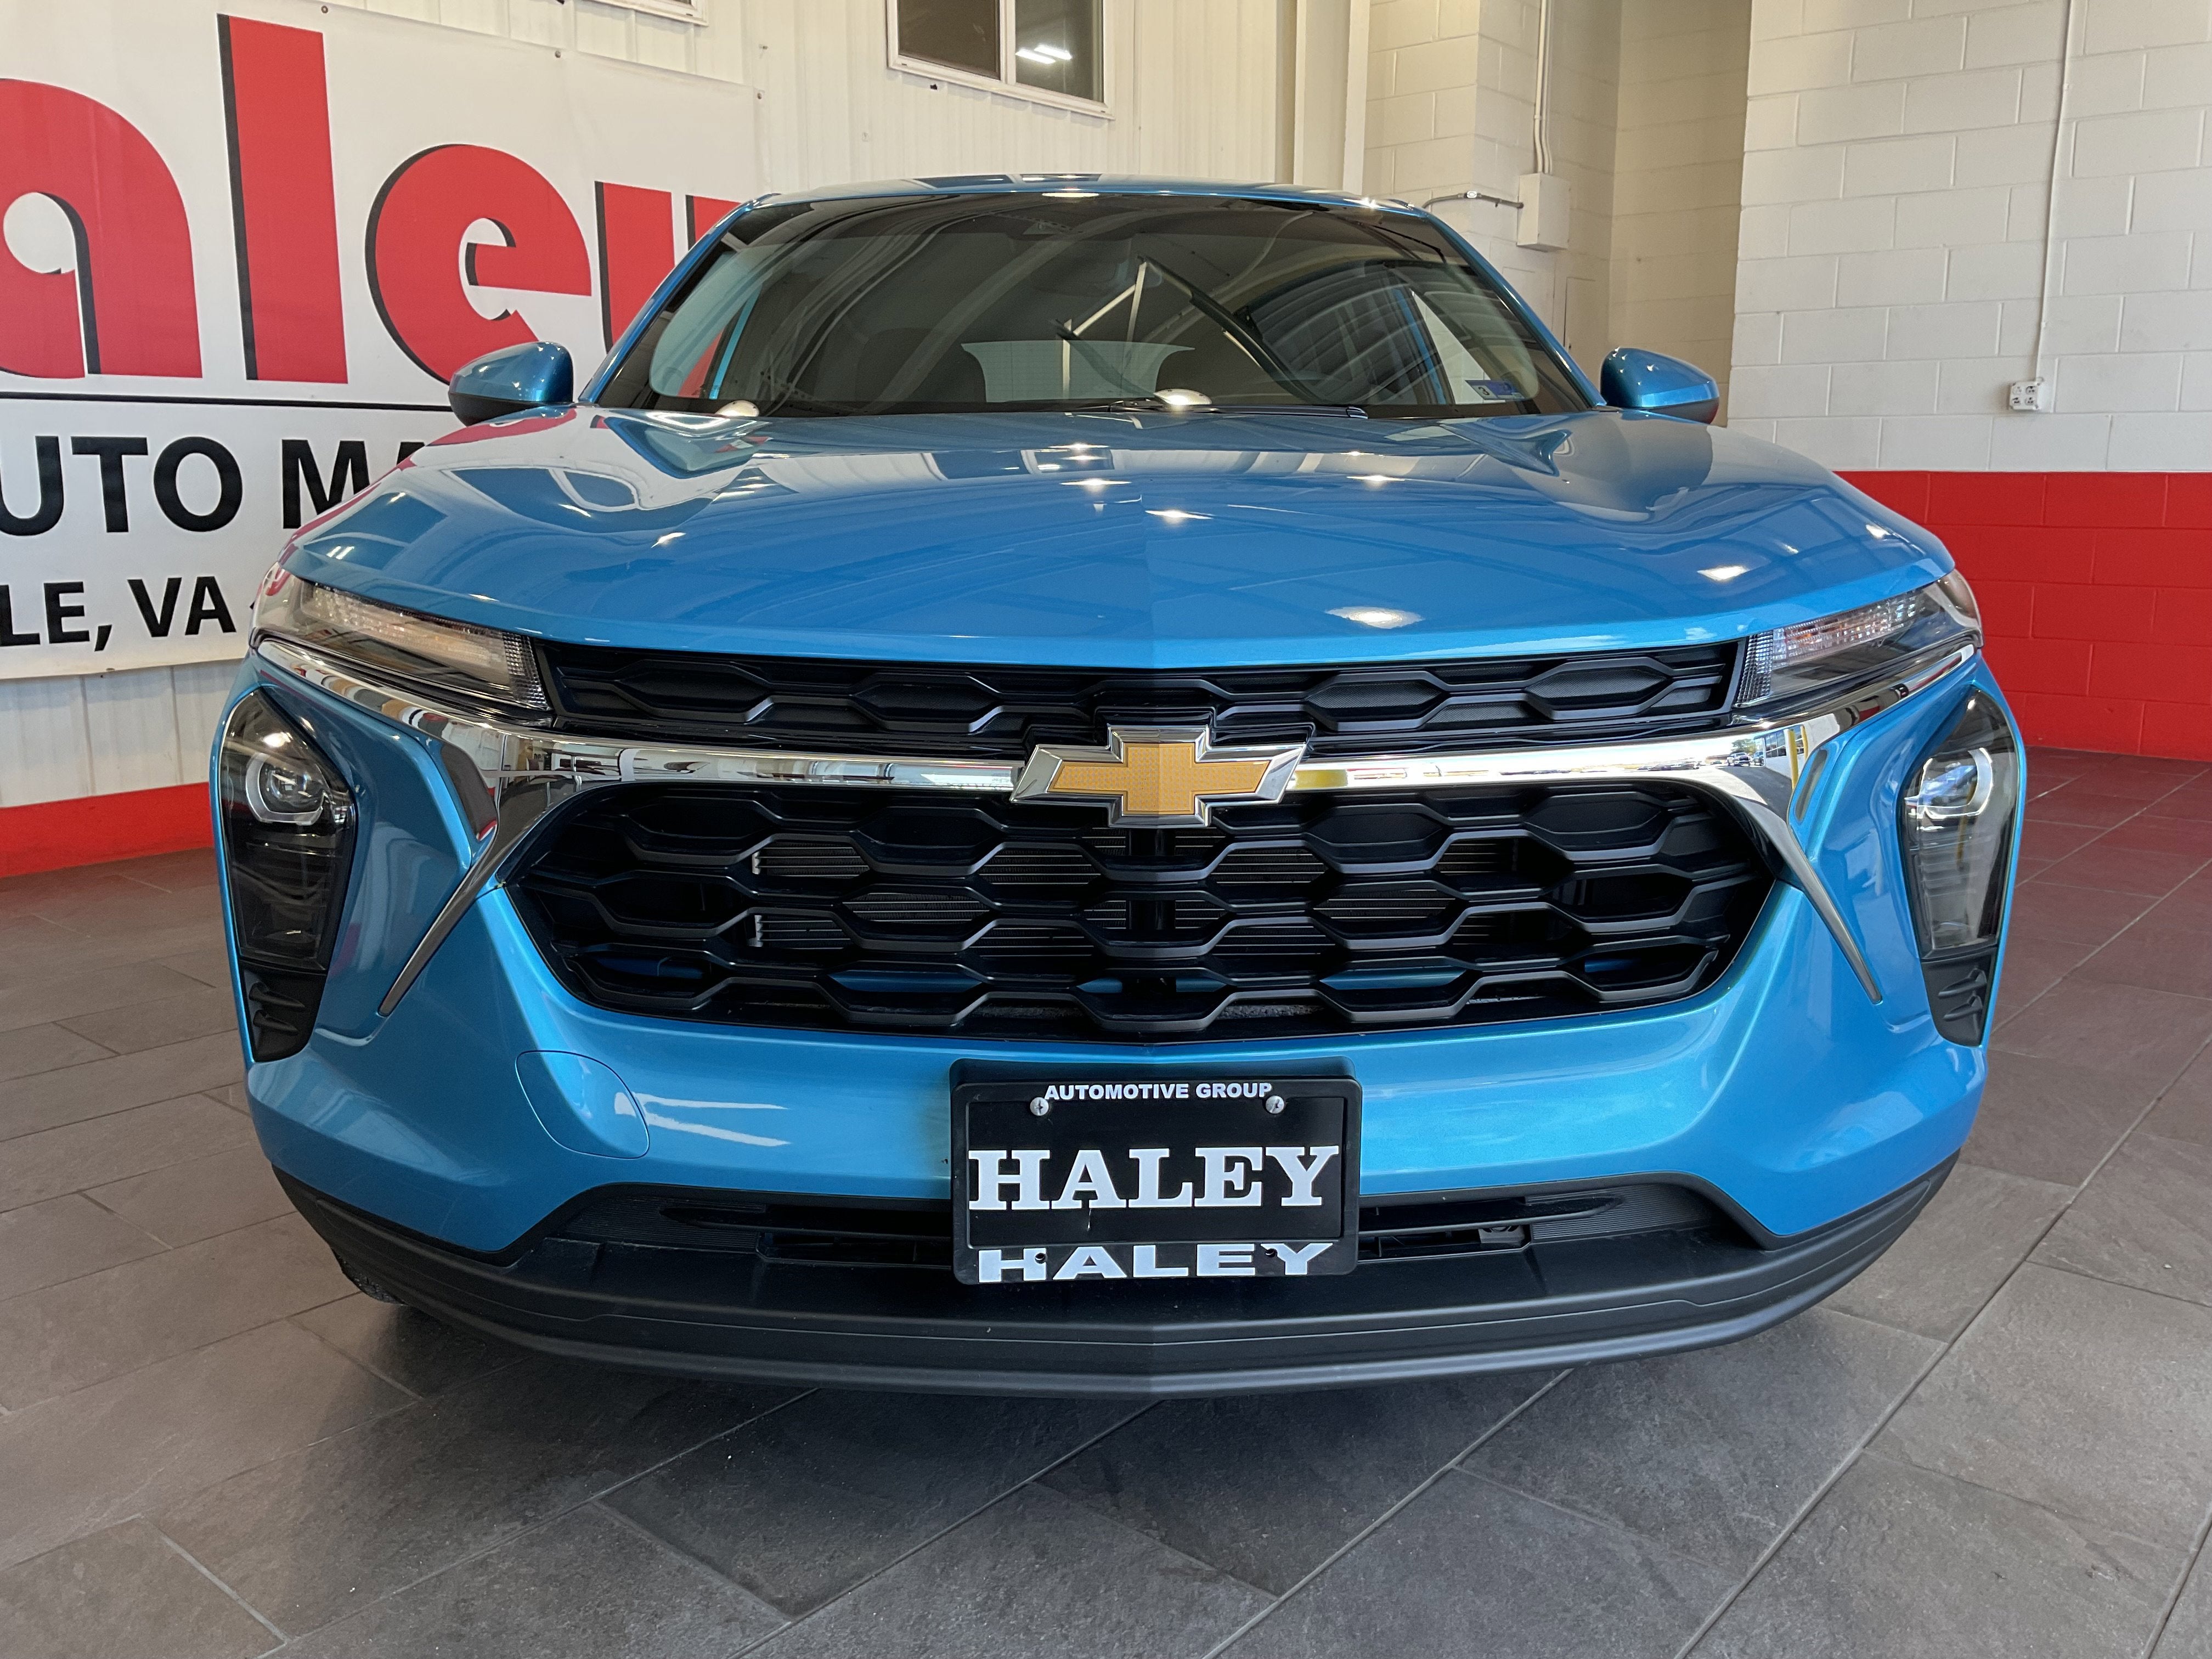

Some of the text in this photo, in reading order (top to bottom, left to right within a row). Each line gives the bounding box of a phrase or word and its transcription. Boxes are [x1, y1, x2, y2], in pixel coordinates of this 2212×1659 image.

[281, 439, 426, 529] M
[0, 576, 236, 652] LE, VA
[1044, 1082, 1273, 1101] AUTOMOTIVE GROUP
[967, 1144, 1340, 1211] HALEY
[978, 1242, 1334, 1284] HALEY
